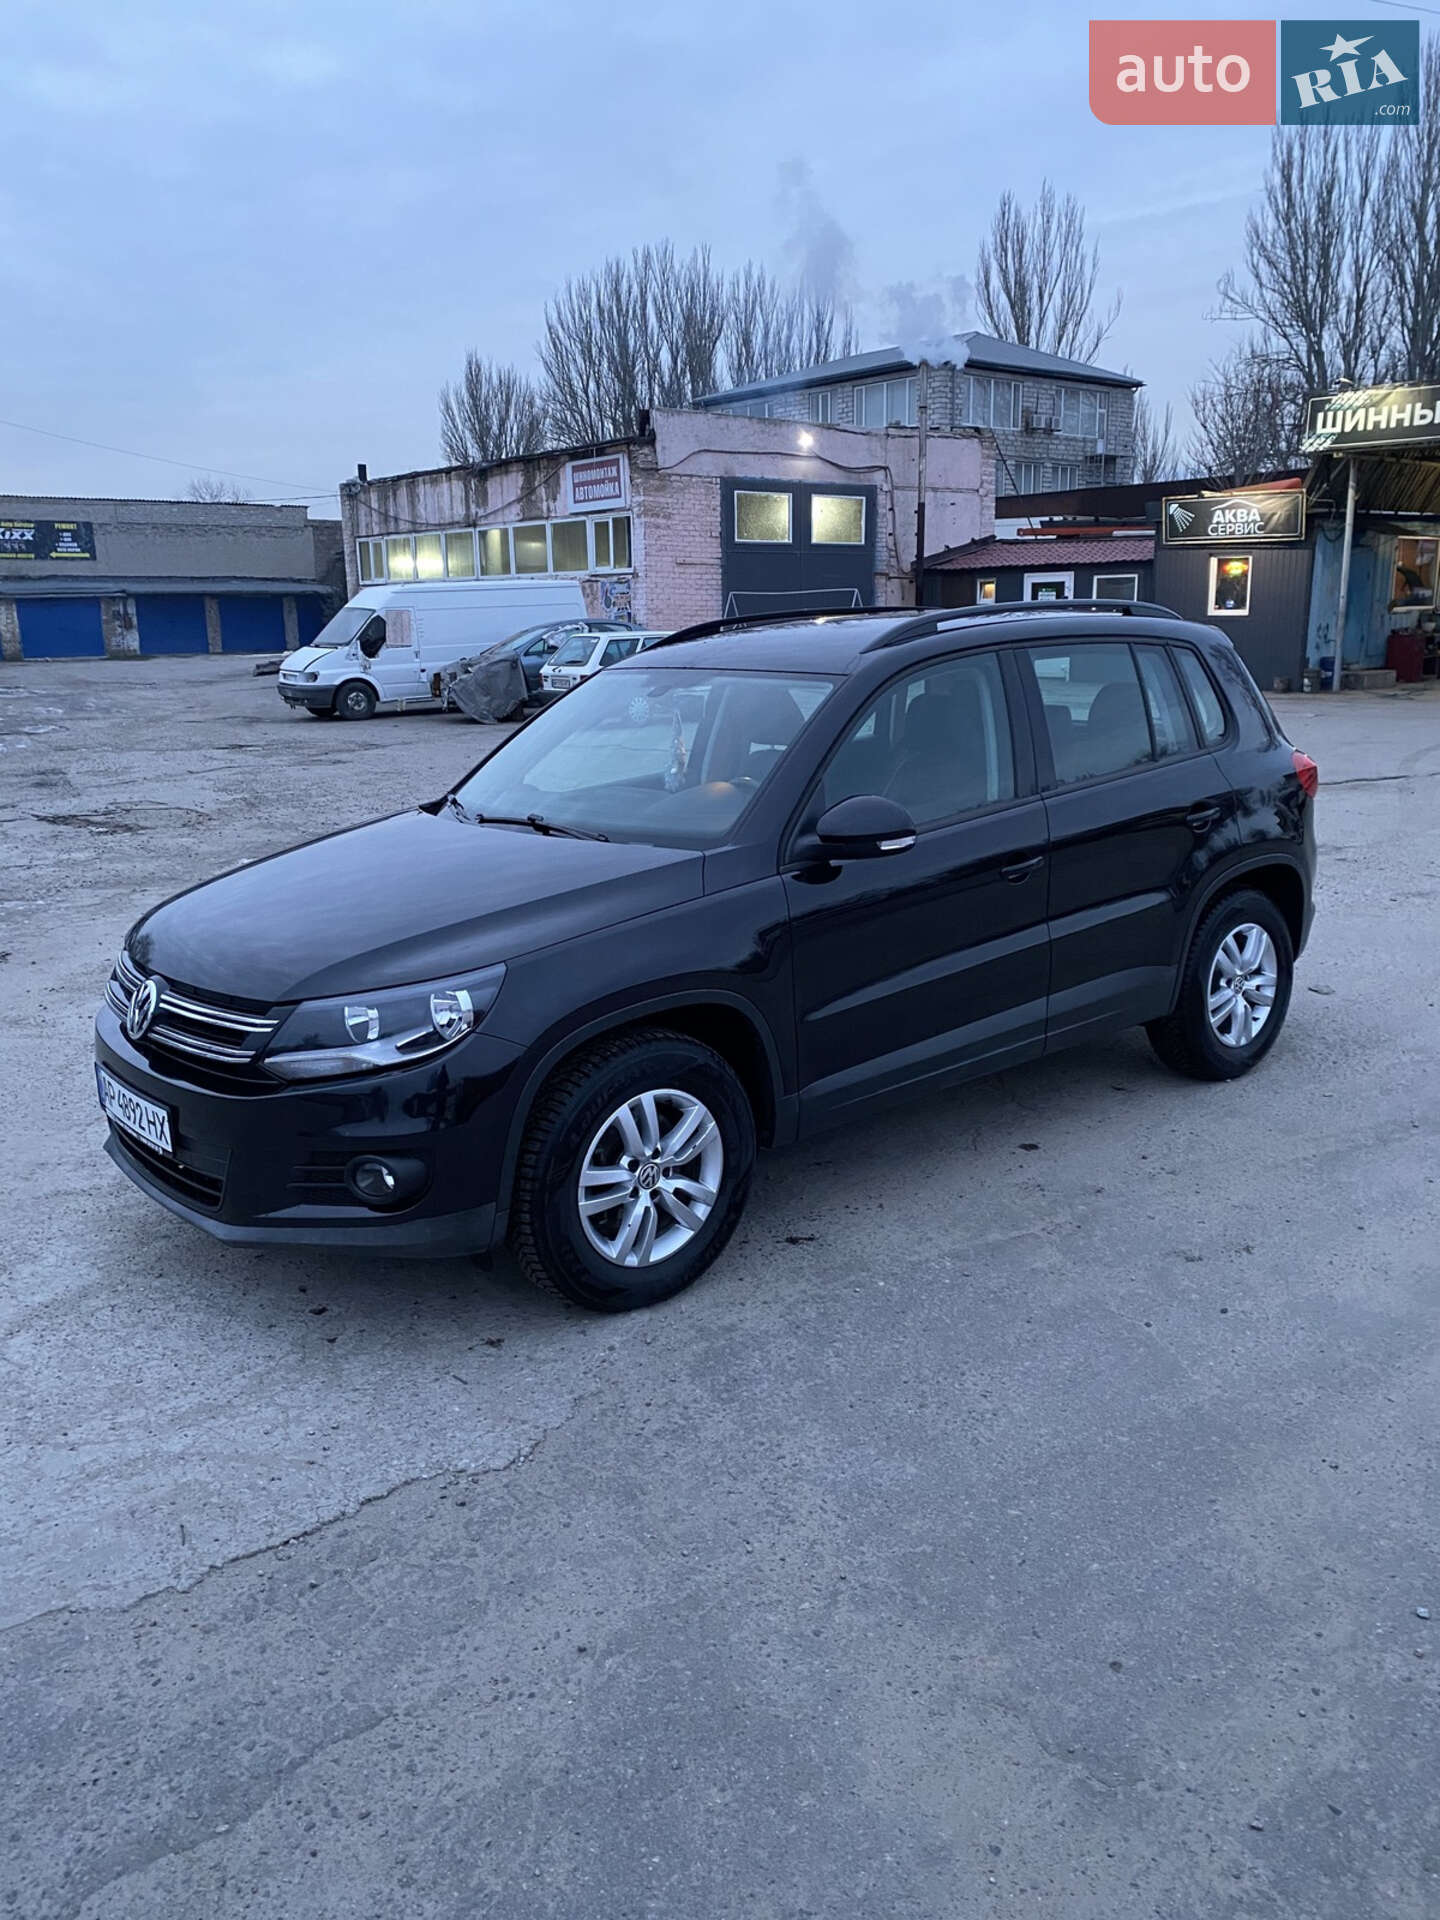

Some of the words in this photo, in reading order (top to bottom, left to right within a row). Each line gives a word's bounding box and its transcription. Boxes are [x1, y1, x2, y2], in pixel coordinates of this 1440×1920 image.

[574, 480, 620, 501] АВТОМОЙКА
[1211, 508, 1261, 524] АКВА
[1207, 521, 1265, 536] СЕРВИС
[117, 1089, 146, 1131] 4892
[144, 1106, 170, 1145] HX
